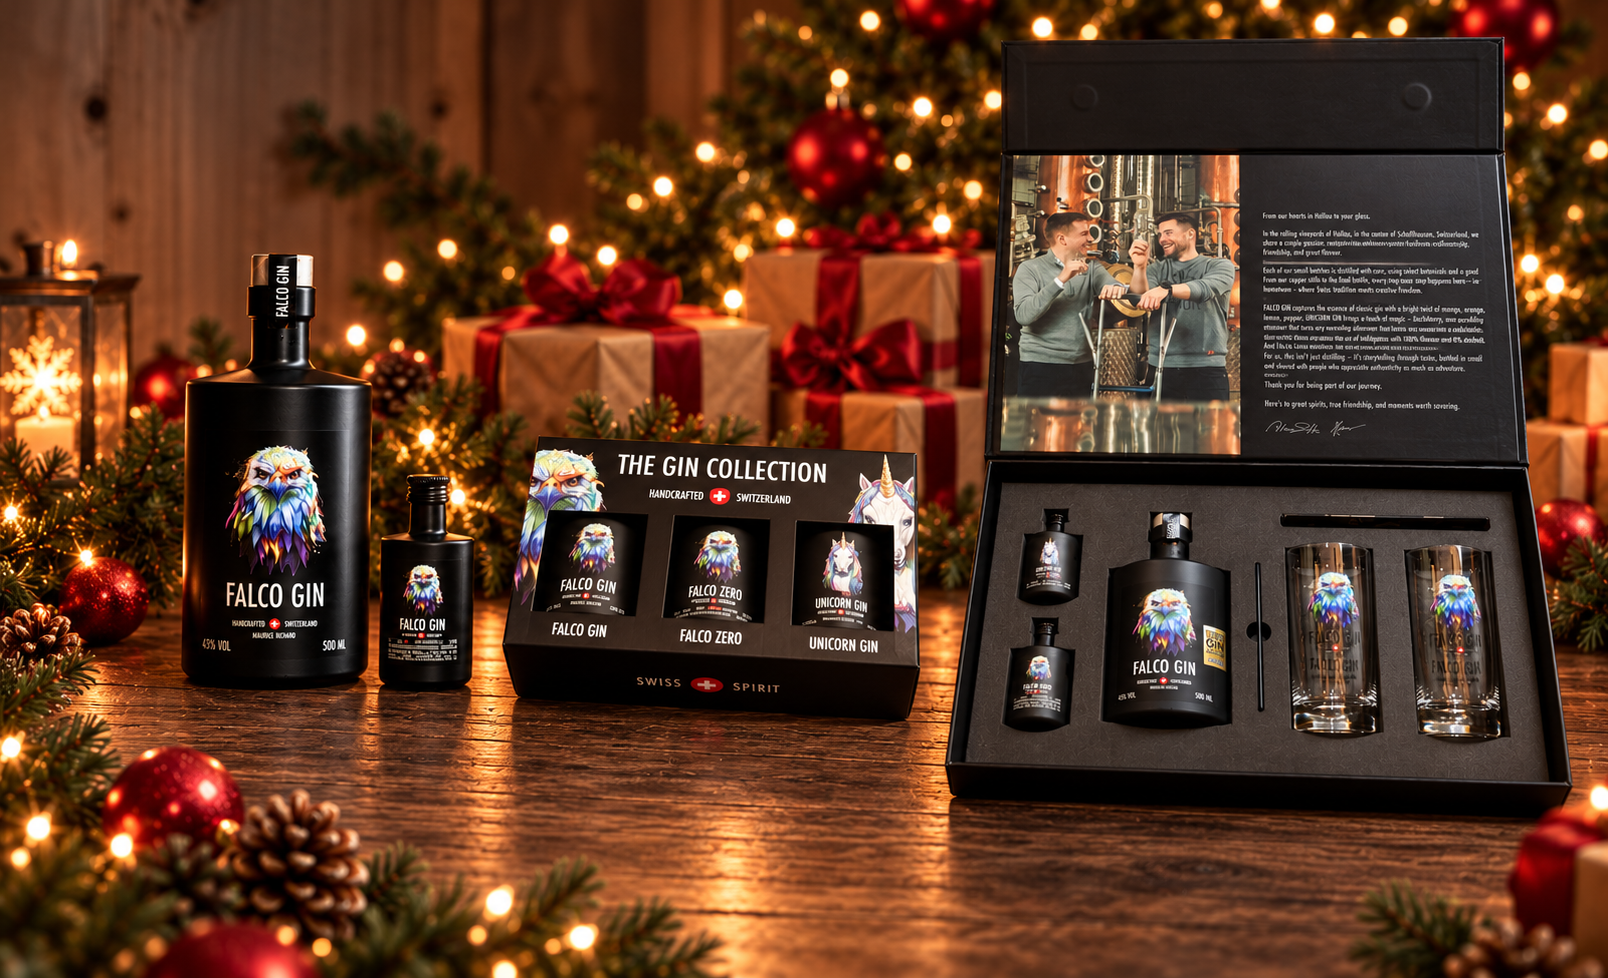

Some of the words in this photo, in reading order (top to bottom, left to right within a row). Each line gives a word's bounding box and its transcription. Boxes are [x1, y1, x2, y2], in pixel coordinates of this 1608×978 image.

[276, 265, 290, 284] GIN
[276, 287, 289, 318] FALCO
[1307, 382, 1323, 390] being
[618, 454, 656, 476] THE
[662, 456, 699, 478] GIN
[706, 458, 827, 484] COLLECTION
[649, 489, 704, 501] HANDCRAFTED
[736, 493, 791, 505] SWITZERLAND
[560, 577, 593, 592] FALCO
[596, 578, 617, 595] GIN
[688, 584, 717, 598] FALCO
[719, 585, 742, 601] ZERO
[226, 582, 283, 609] FALCO
[291, 582, 325, 609] GIN
[815, 596, 852, 609] UNICORN
[854, 599, 868, 613] GIN
[400, 617, 426, 631] FALCO
[429, 618, 446, 631] GIN
[551, 622, 585, 637] FALCO
[587, 623, 608, 638] GIN
[322, 639, 336, 652] 500
[336, 638, 347, 651] ML
[679, 628, 713, 644] FALCO
[714, 630, 743, 645] ZERO
[809, 636, 857, 652] UNICORN
[859, 639, 879, 653] GIN
[217, 639, 231, 652] VOL
[1133, 659, 1170, 676] FALCO
[1174, 660, 1196, 676] GIN
[636, 676, 682, 688] SWISS
[732, 682, 781, 693] SPIRIT
